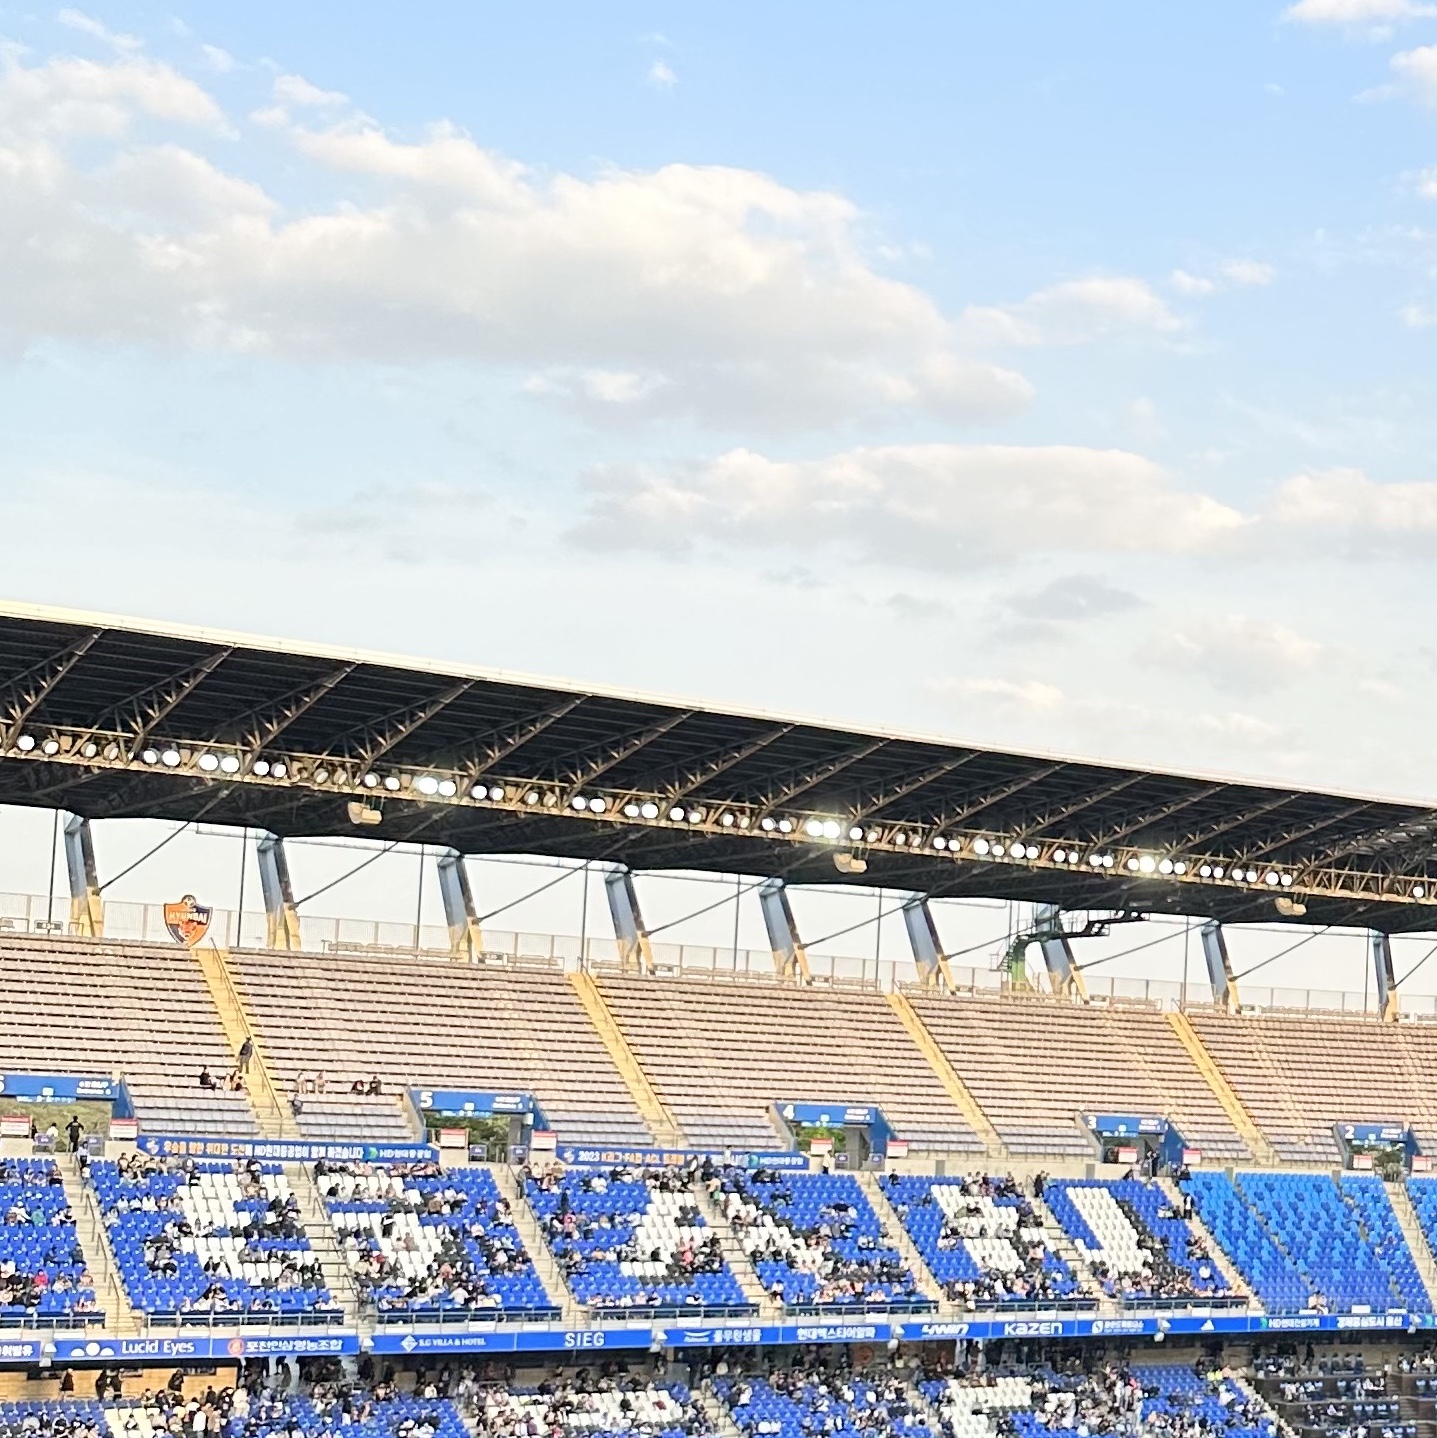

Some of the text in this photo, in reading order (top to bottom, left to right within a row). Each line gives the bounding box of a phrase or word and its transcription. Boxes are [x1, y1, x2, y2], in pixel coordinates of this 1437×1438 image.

[420, 1092, 433, 1108] 5
[782, 1104, 795, 1120] 4
[1087, 1116, 1097, 1130] 3
[1345, 1126, 1355, 1140] 2
[121, 1340, 194, 1356] Lucid Eyes
[461, 1337, 486, 1346] HOTEL
[564, 1333, 605, 1348] SIEG
